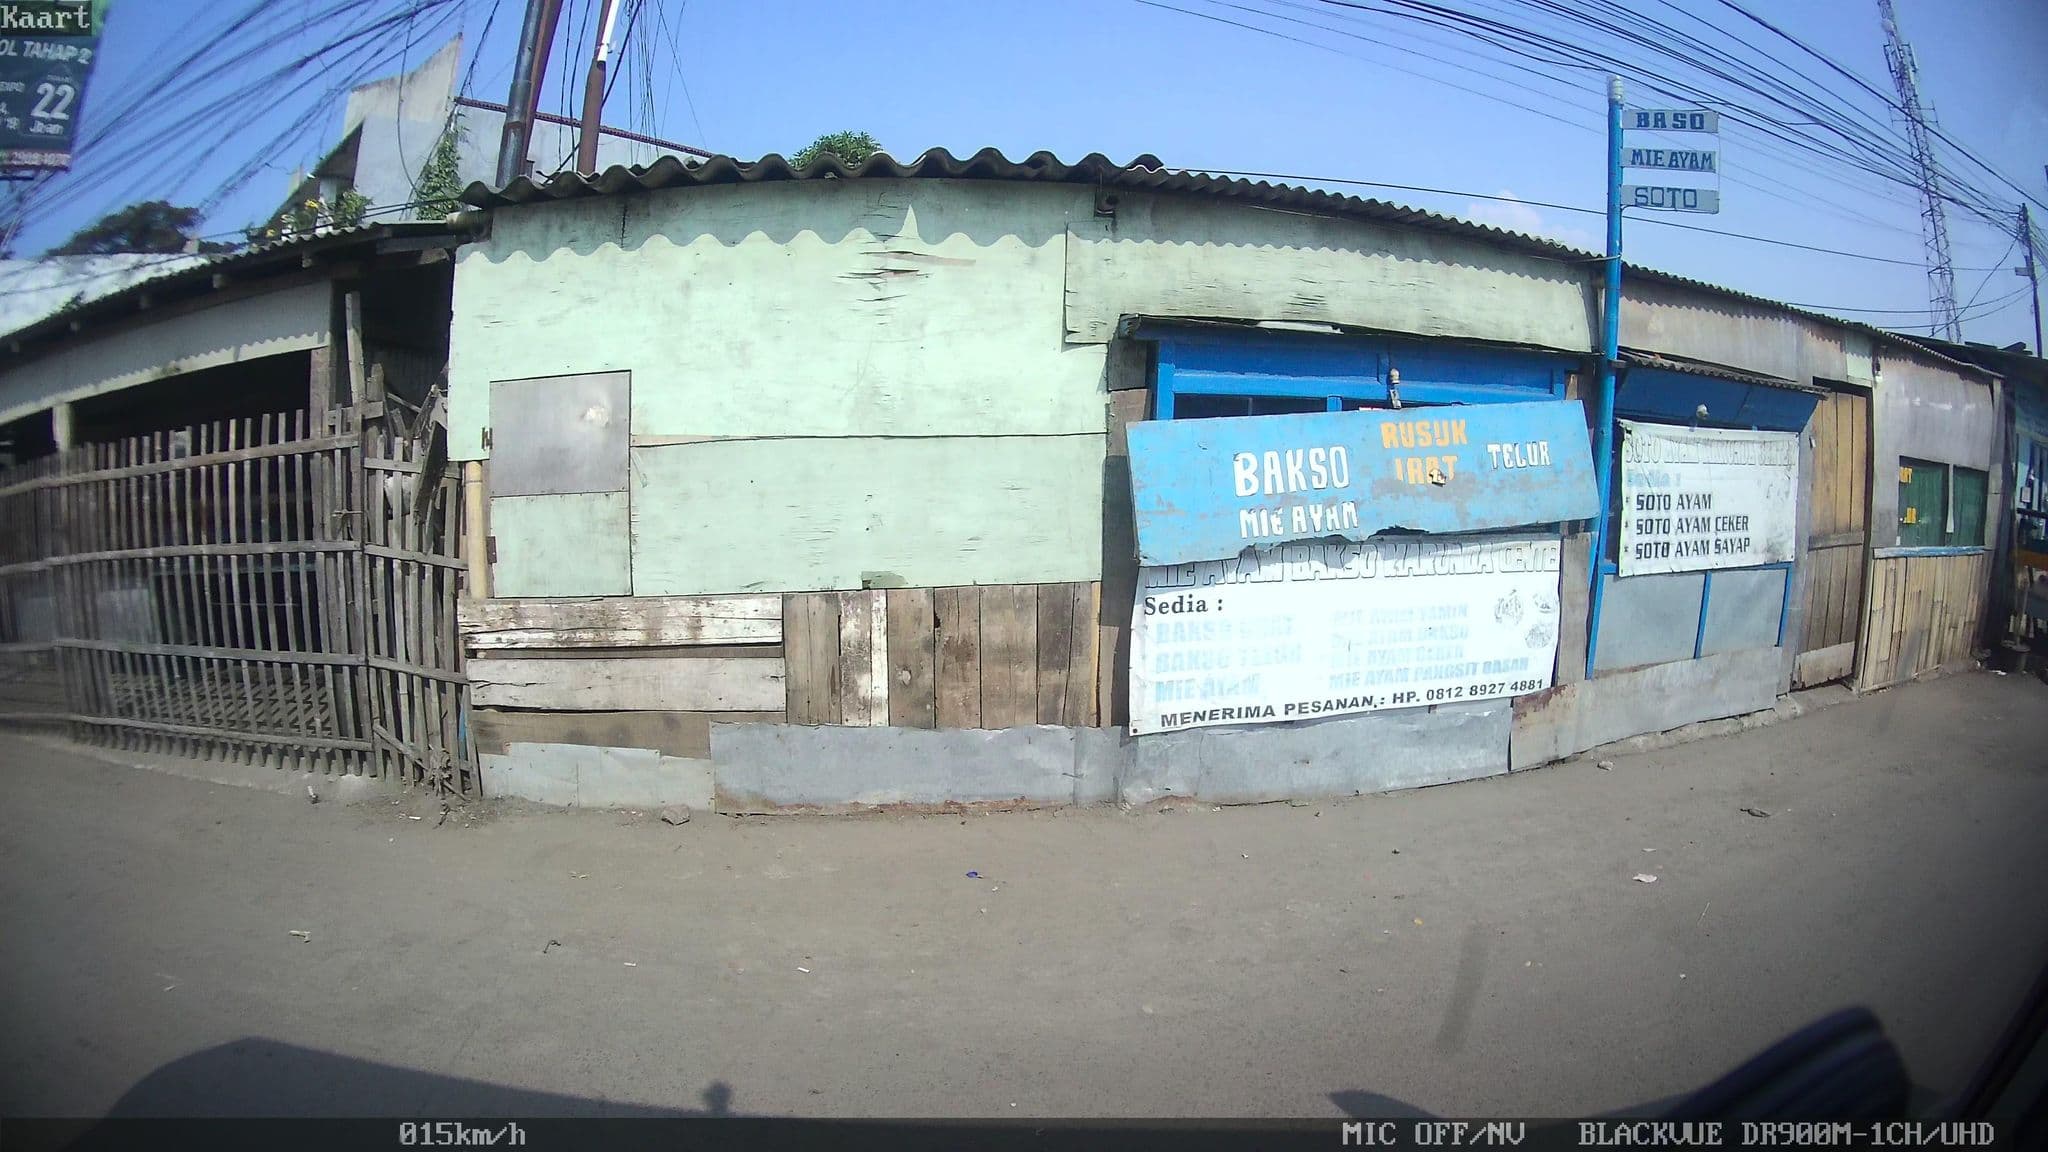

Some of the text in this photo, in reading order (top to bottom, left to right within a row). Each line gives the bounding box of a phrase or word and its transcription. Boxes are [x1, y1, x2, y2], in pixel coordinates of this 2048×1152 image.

[31, 82, 75, 120] 22
[1636, 112, 1705, 130] BASO
[1631, 149, 1715, 170] MIE AYAM
[1634, 187, 1698, 209] SOTO
[1380, 420, 1467, 449] RUSUK
[1487, 440, 1551, 470] TELUR
[1233, 445, 1350, 497] BAKSO
[1636, 493, 1712, 511] SOTO AYAM
[1239, 501, 1359, 539] MIE AYAM
[1636, 515, 1749, 535] SOTO AYAM CEKER
[1290, 543, 1377, 580] BAKSO
[1635, 537, 1750, 560] SOTO AYAM SAYAP
[1144, 593, 1208, 616] Sedia
[1160, 704, 1276, 728] MENERIMA
[1392, 690, 1421, 705] HP.
[1426, 686, 1463, 701] 0812
[1469, 682, 1506, 697] 8927
[1510, 678, 1543, 692] 4881
